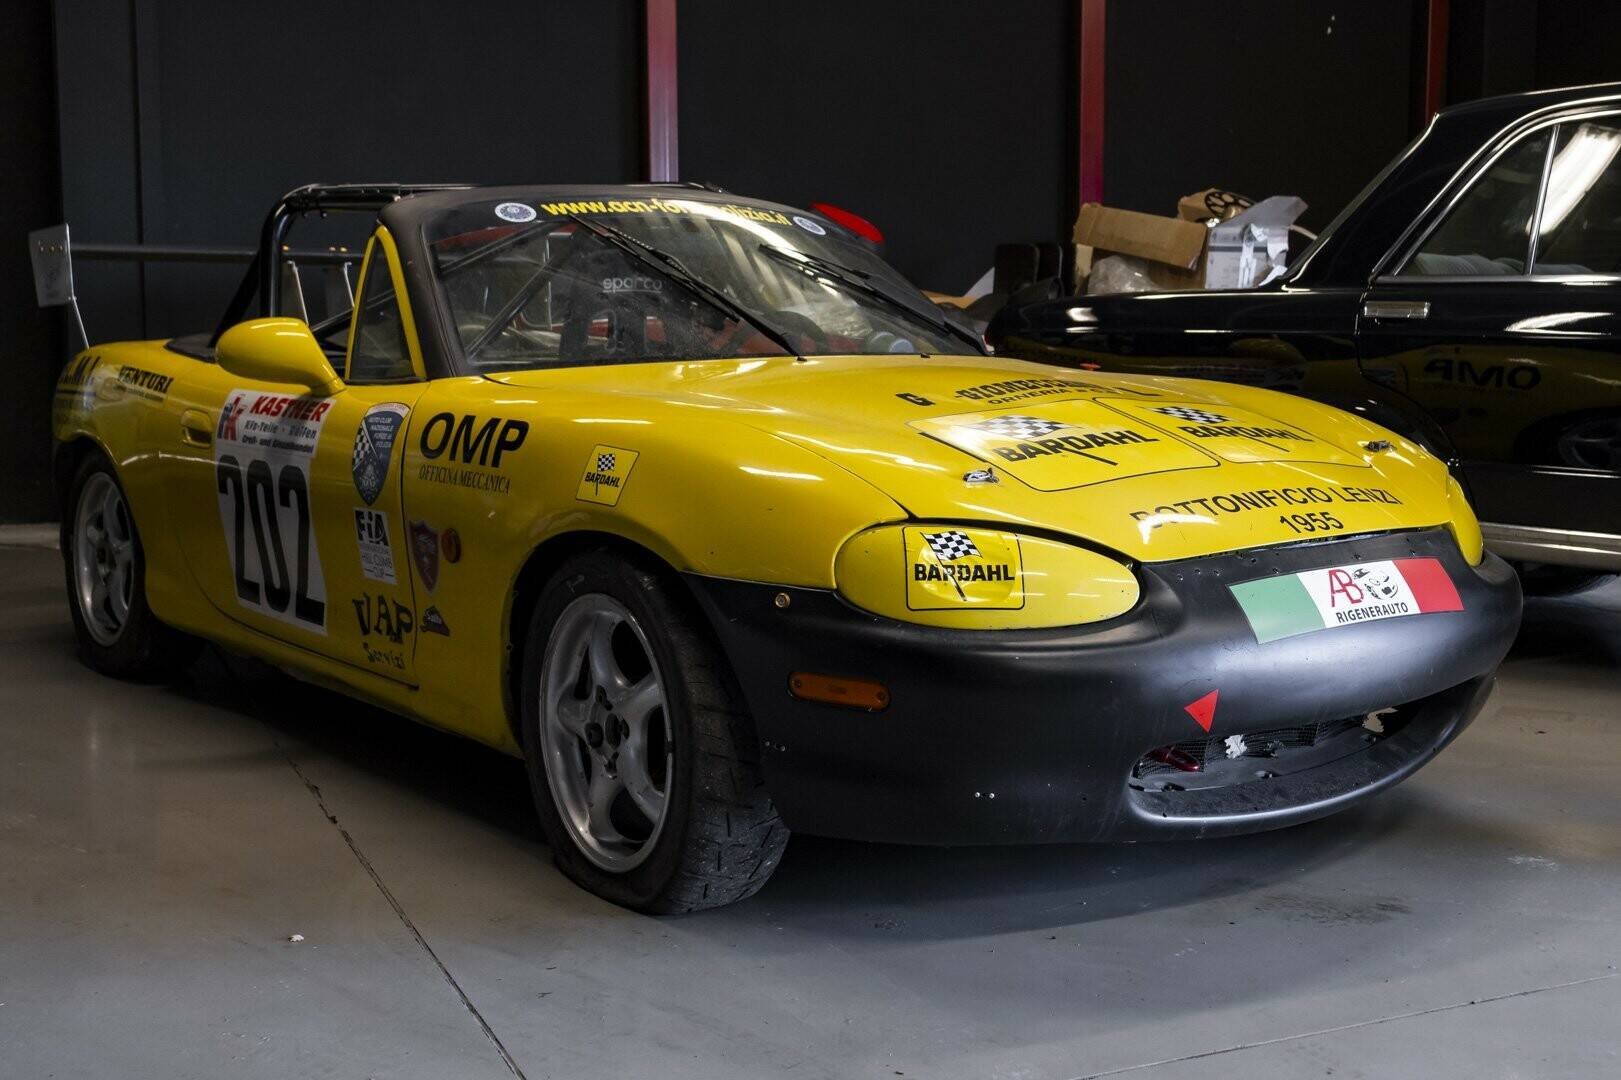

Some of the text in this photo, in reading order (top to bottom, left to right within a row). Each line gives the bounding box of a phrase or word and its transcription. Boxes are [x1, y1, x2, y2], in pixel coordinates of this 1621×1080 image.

[602, 277, 663, 293] sparco
[119, 365, 174, 393] VENTURI
[250, 396, 331, 422] KASTNER
[895, 392, 936, 407] G
[419, 412, 530, 468] OMP
[1178, 425, 1313, 442] BARDAHL
[994, 429, 1160, 462] BARDAHL
[584, 471, 621, 489] BARDAHL
[1331, 487, 1403, 505] LENZI
[1279, 511, 1344, 534] 1955
[217, 454, 325, 627] 202
[914, 563, 1015, 581] BARDAHL
[1328, 569, 1364, 608] AB
[1335, 602, 1409, 623] RIGENERAUTO
